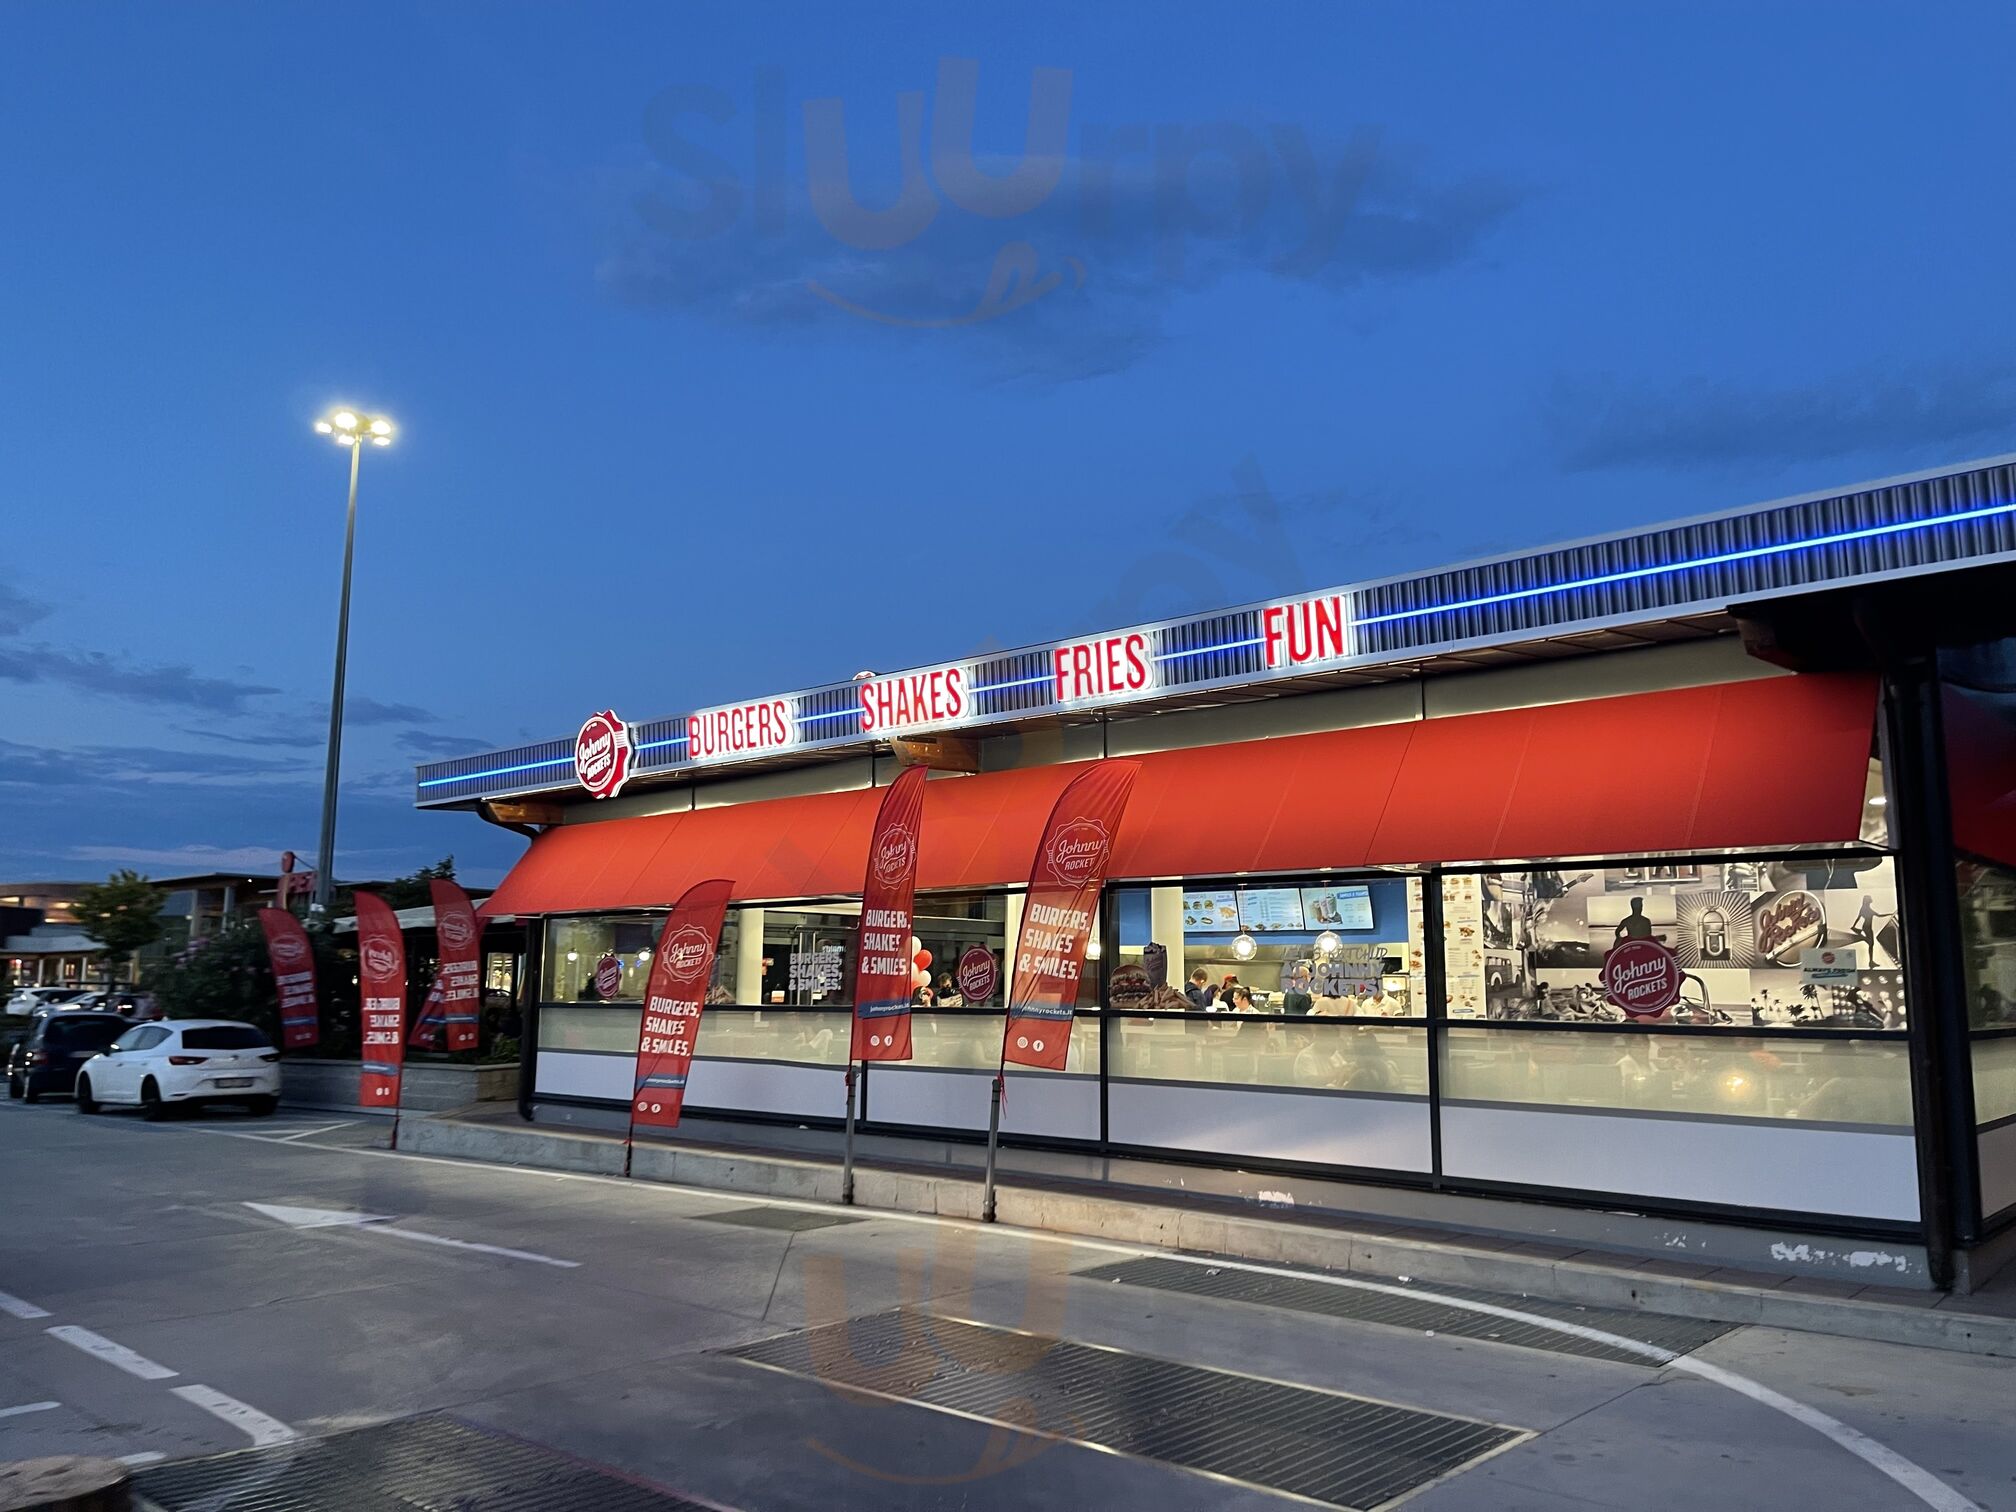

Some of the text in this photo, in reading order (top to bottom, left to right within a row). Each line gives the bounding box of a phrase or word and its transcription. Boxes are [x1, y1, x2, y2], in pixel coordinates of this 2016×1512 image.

[688, 596, 1345, 757] BURGERS SHAKES FRIES FUN
[579, 731, 611, 773] Johnny
[586, 753, 611, 780] ROCKETS
[1065, 858, 1095, 870] ROCKET
[669, 940, 707, 964] Johnny
[789, 952, 842, 965] BURGERS,
[1019, 953, 1031, 972] &
[789, 964, 842, 980] SHAKES,
[861, 956, 869, 973] &
[963, 960, 990, 987] Johnny
[1613, 957, 1667, 993] Johnny
[970, 975, 990, 992] ROCKETS
[1628, 978, 1667, 1000] ROCKETS
[649, 996, 700, 1018] BURGERS,
[641, 1037, 650, 1052] &
